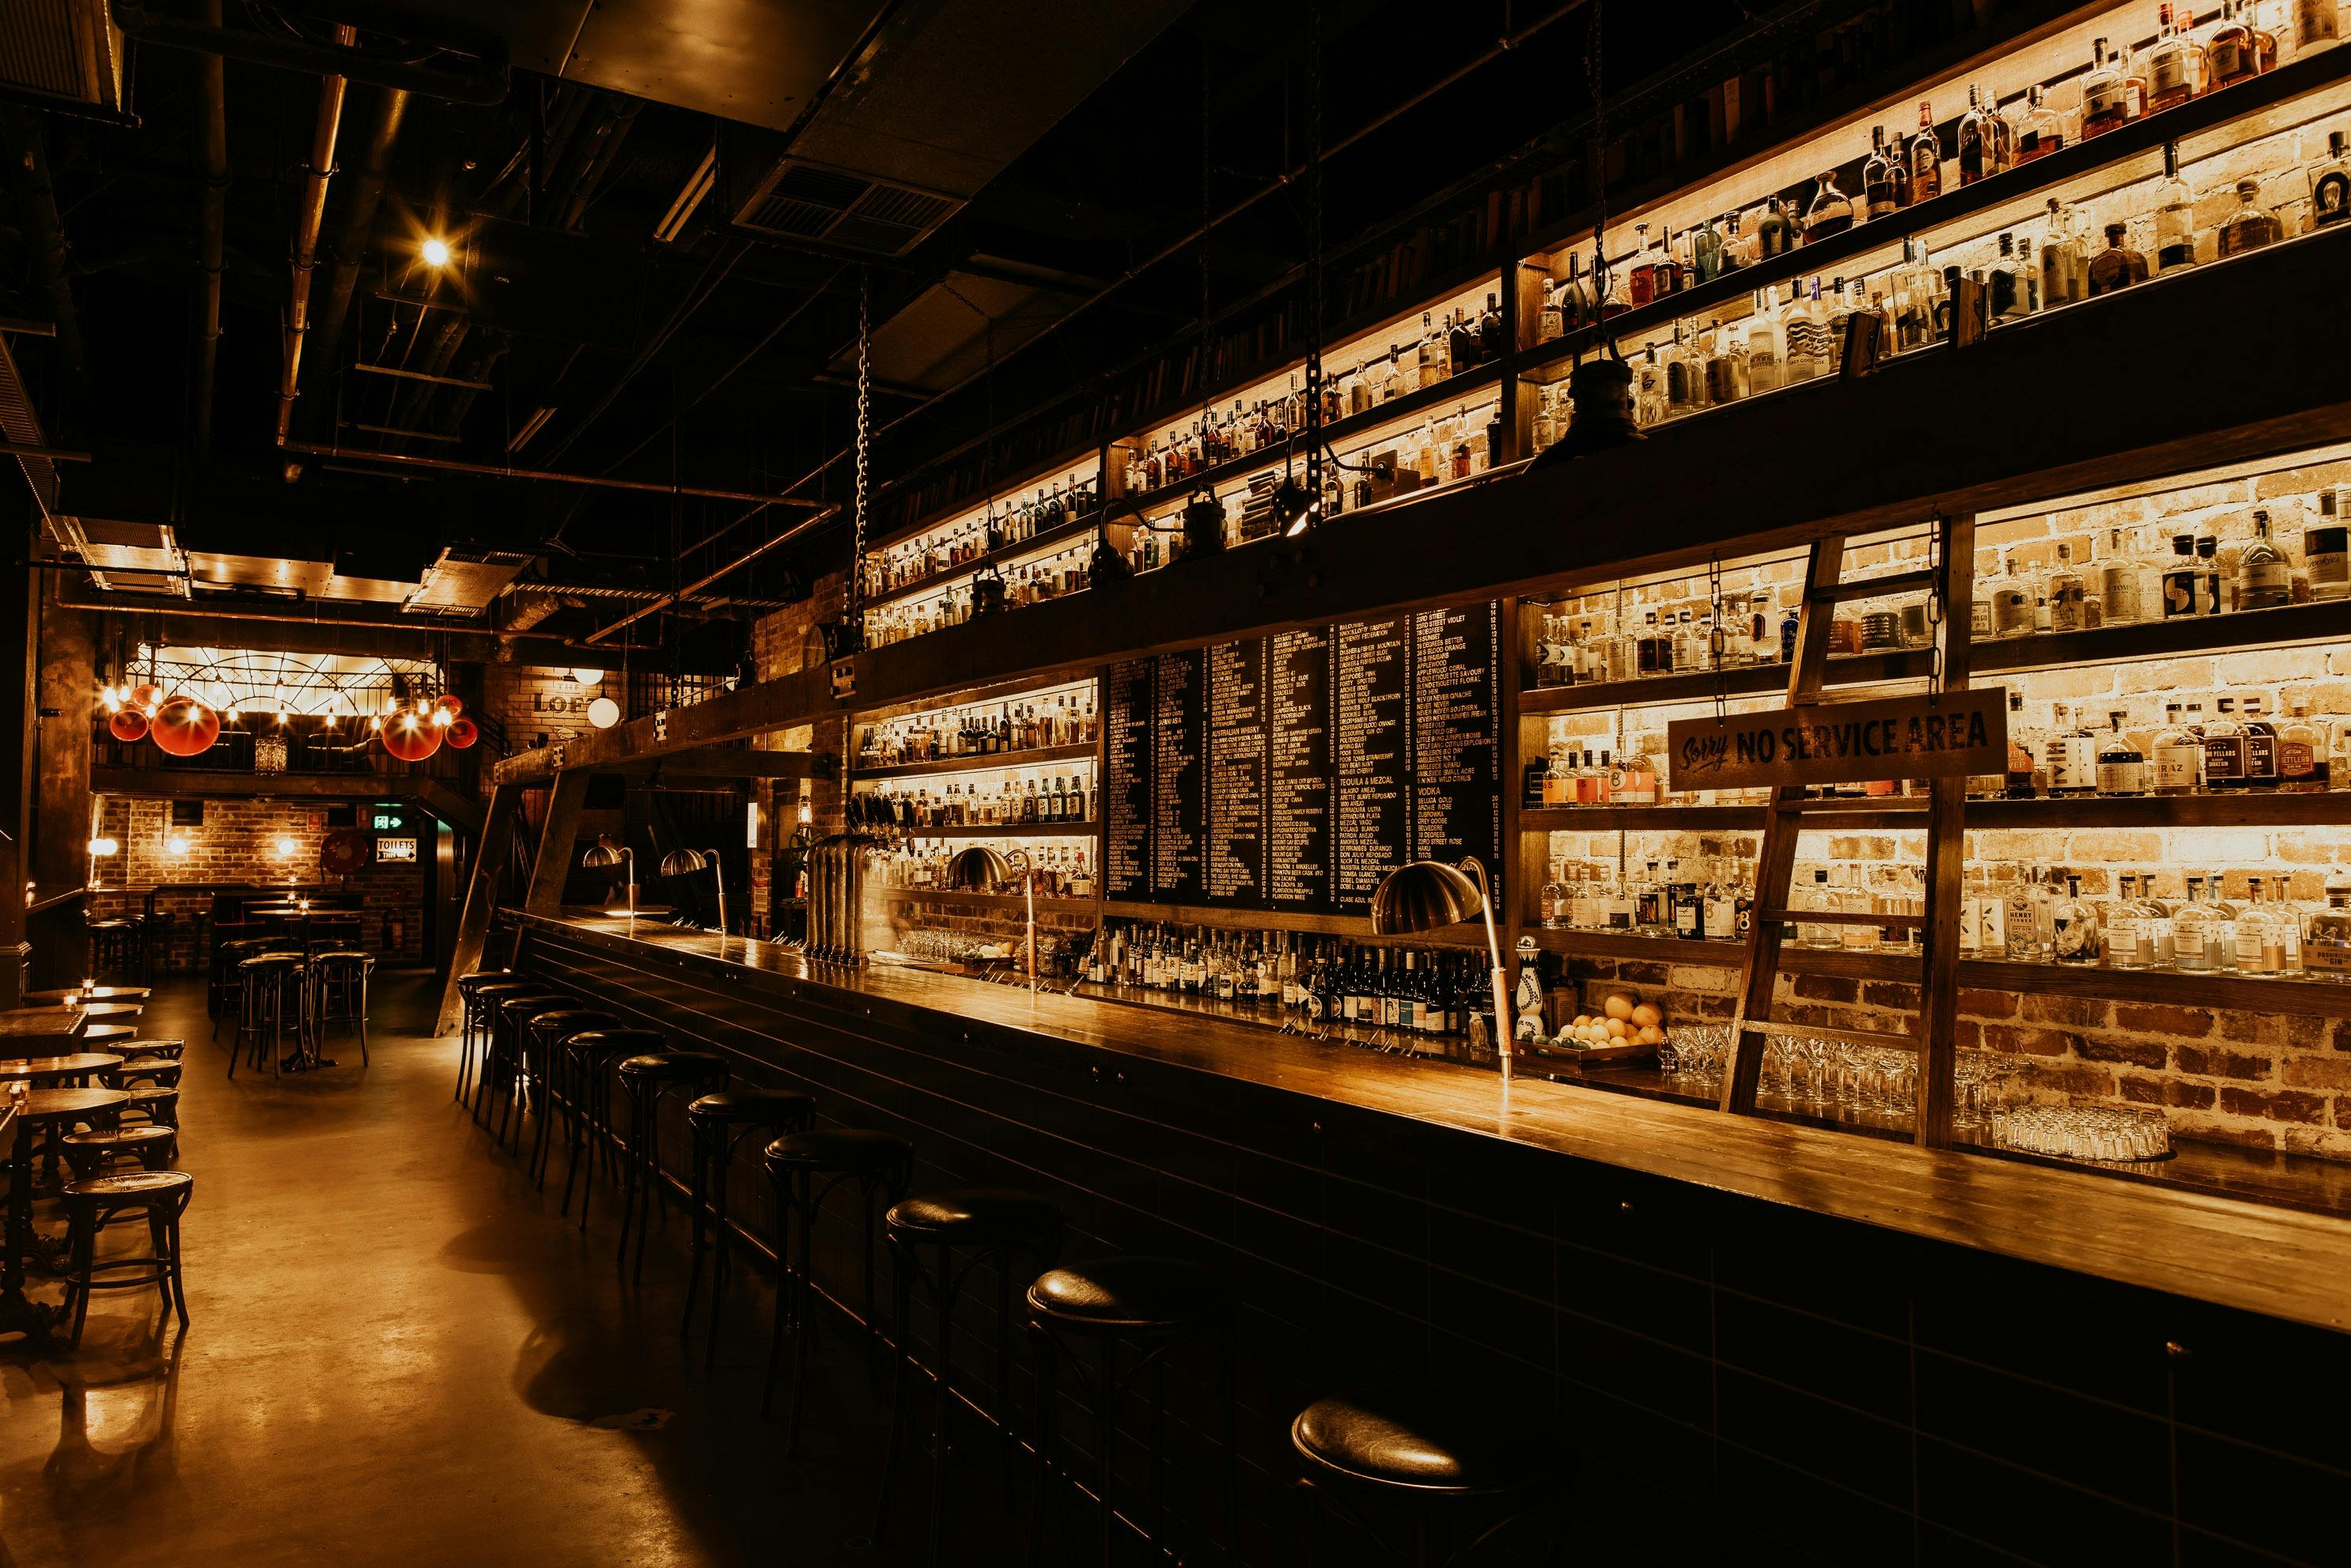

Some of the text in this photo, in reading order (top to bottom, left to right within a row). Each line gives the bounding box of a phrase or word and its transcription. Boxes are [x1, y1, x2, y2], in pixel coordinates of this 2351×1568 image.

[1362, 630, 1388, 639] FEDERATION
[1377, 640, 1400, 650] MOUNTAIN
[1422, 640, 1443, 649] DEGREES
[1444, 636, 1463, 645] BETTER
[1444, 643, 1466, 652] ORANGE
[1416, 667, 1447, 676] APPLEWOOD
[1432, 672, 1459, 680] ETIQUETTE
[1459, 668, 1485, 677] SAVOURY
[1372, 693, 1400, 702] BLACKTHORN
[1450, 704, 1478, 713] SOUTHERN
[1212, 729, 1239, 737] AUSTRALIAN
[1679, 710, 1988, 773] Sorry NO SERVICE AREA
[1340, 778, 1363, 786] TEQUILA
[1418, 786, 1441, 795] VODKA
[378, 841, 415, 850] TOILETS
